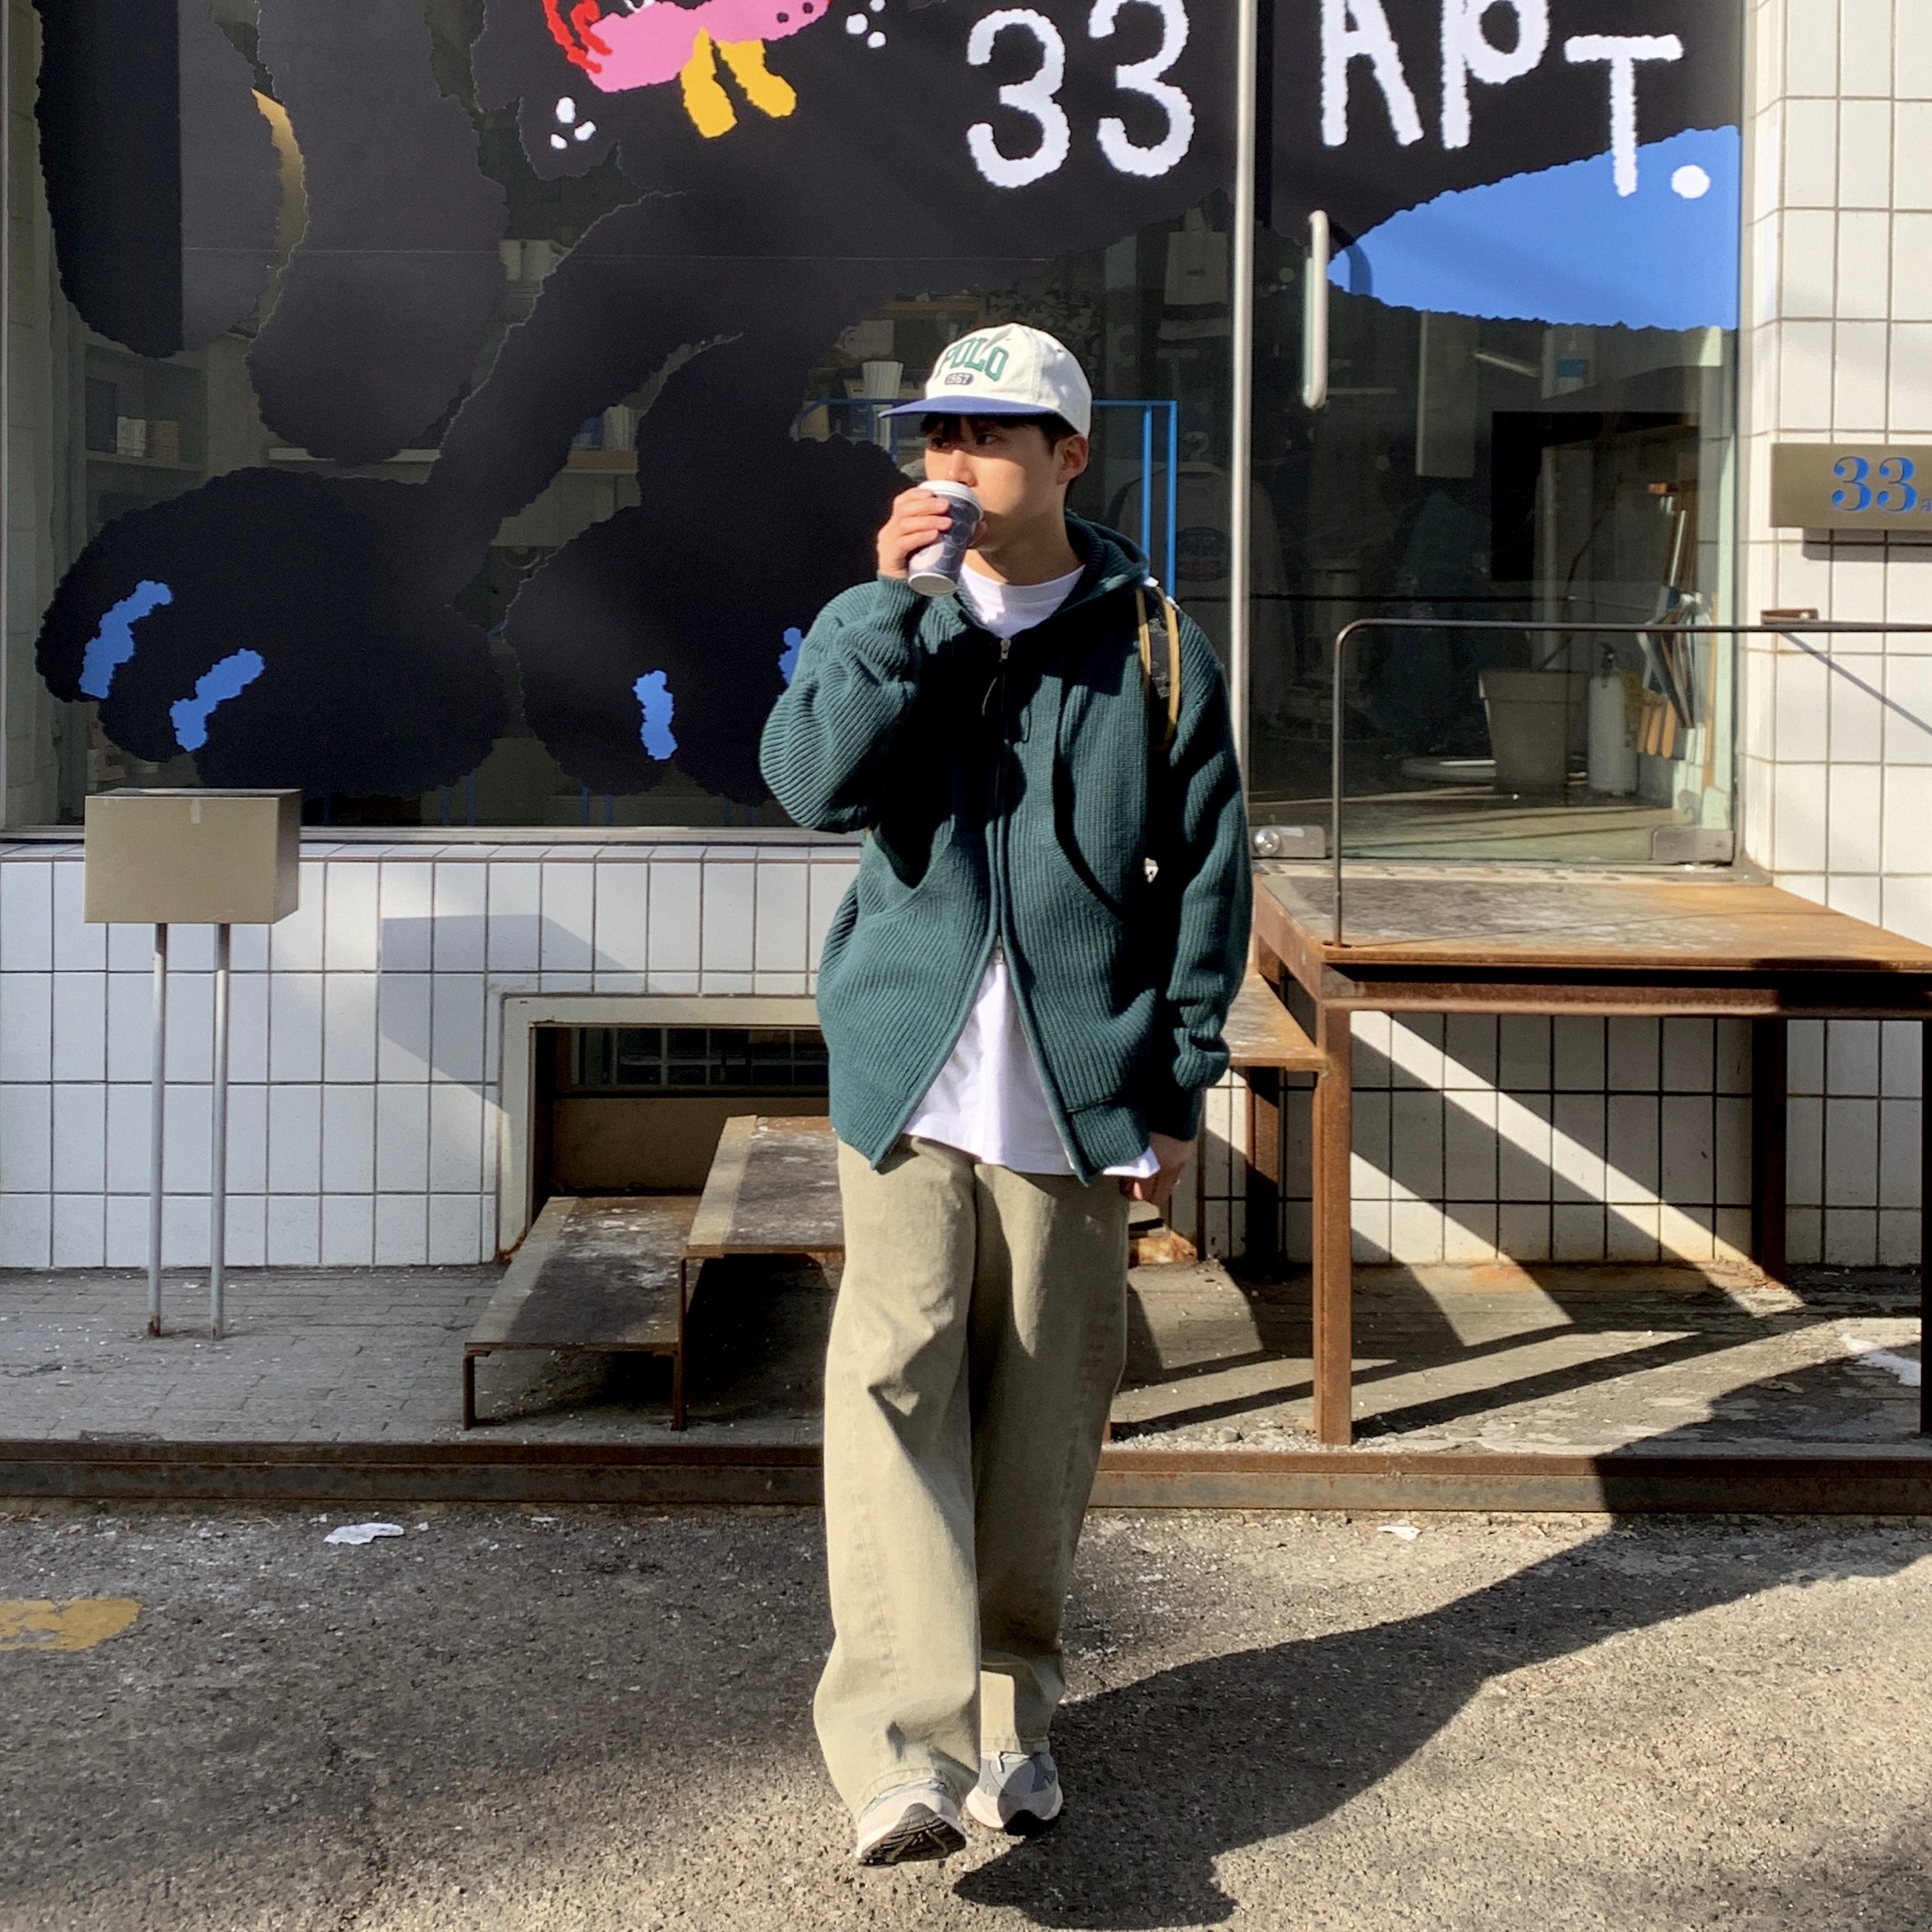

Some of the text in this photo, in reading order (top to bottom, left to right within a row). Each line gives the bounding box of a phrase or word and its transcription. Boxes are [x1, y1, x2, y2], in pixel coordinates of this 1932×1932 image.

[966, 0, 1712, 199] 33 APT.
[933, 337, 1010, 382] POLO
